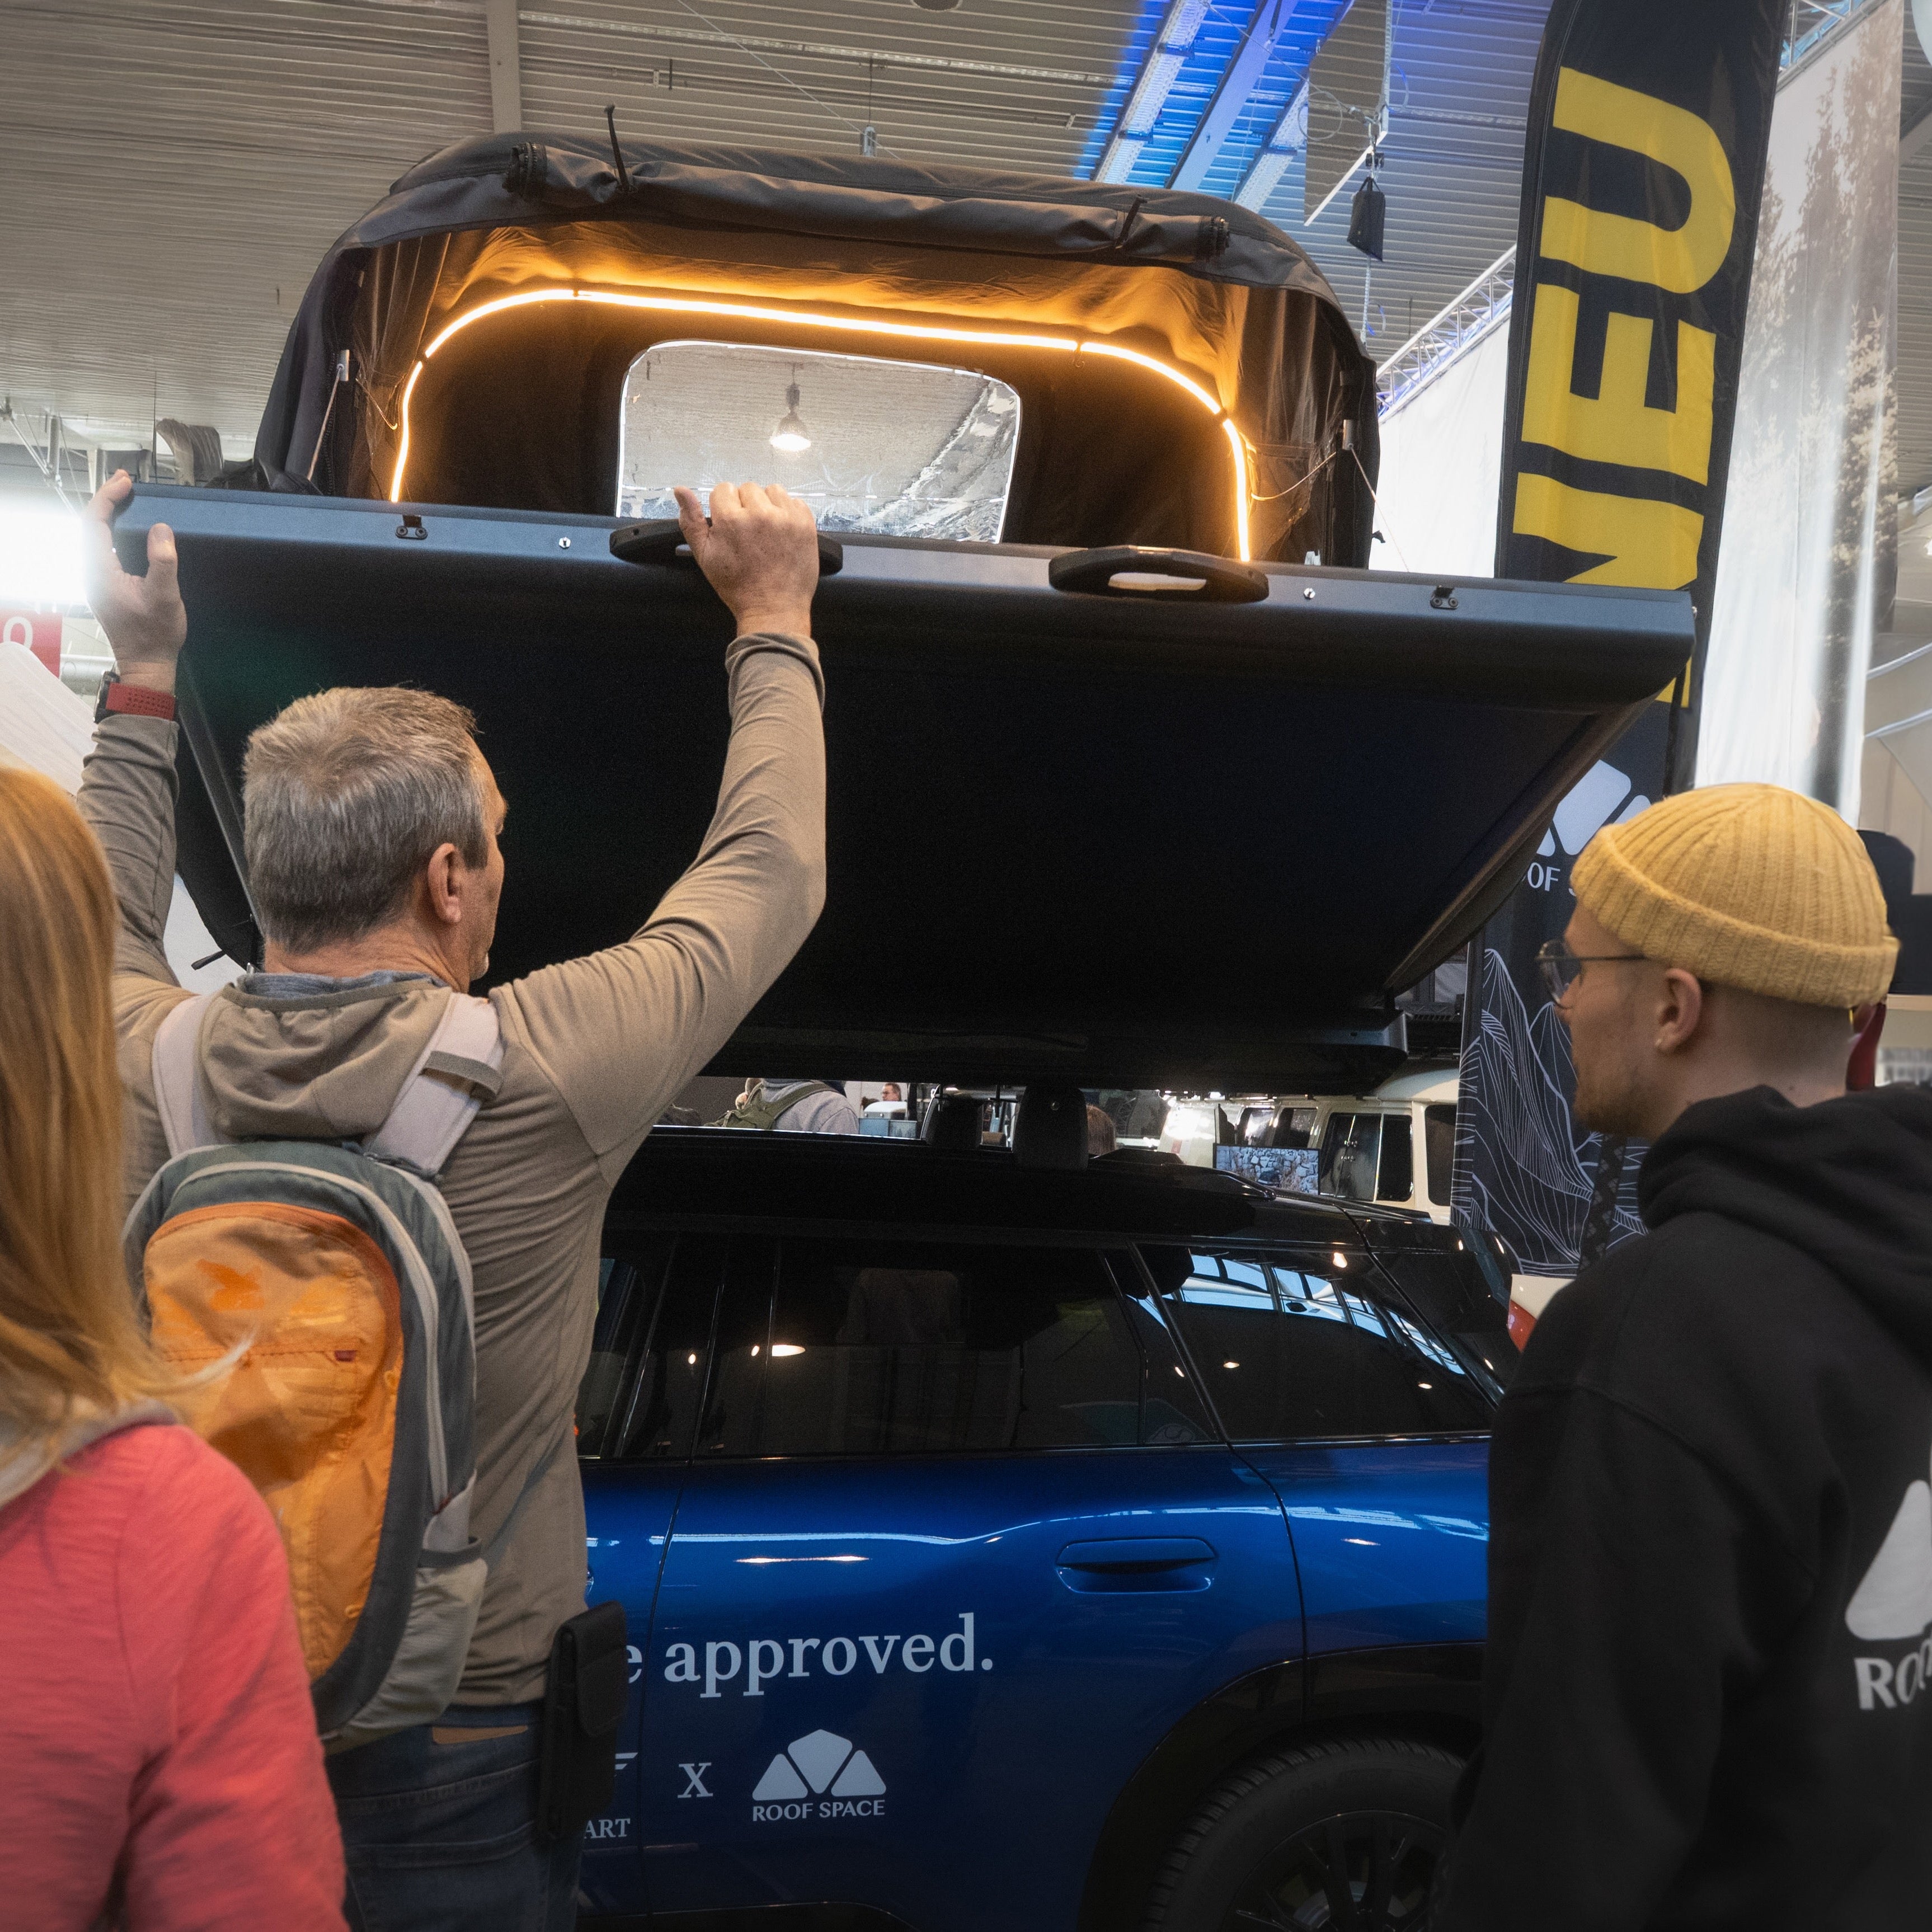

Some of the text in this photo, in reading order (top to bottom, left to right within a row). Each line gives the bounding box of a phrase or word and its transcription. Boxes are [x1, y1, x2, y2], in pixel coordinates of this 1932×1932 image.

[1521, 862, 1561, 891] OF
[664, 1612, 993, 1698] approved.
[753, 1799, 885, 1821] ROOF SPACE
[584, 1818, 631, 1839] ART
